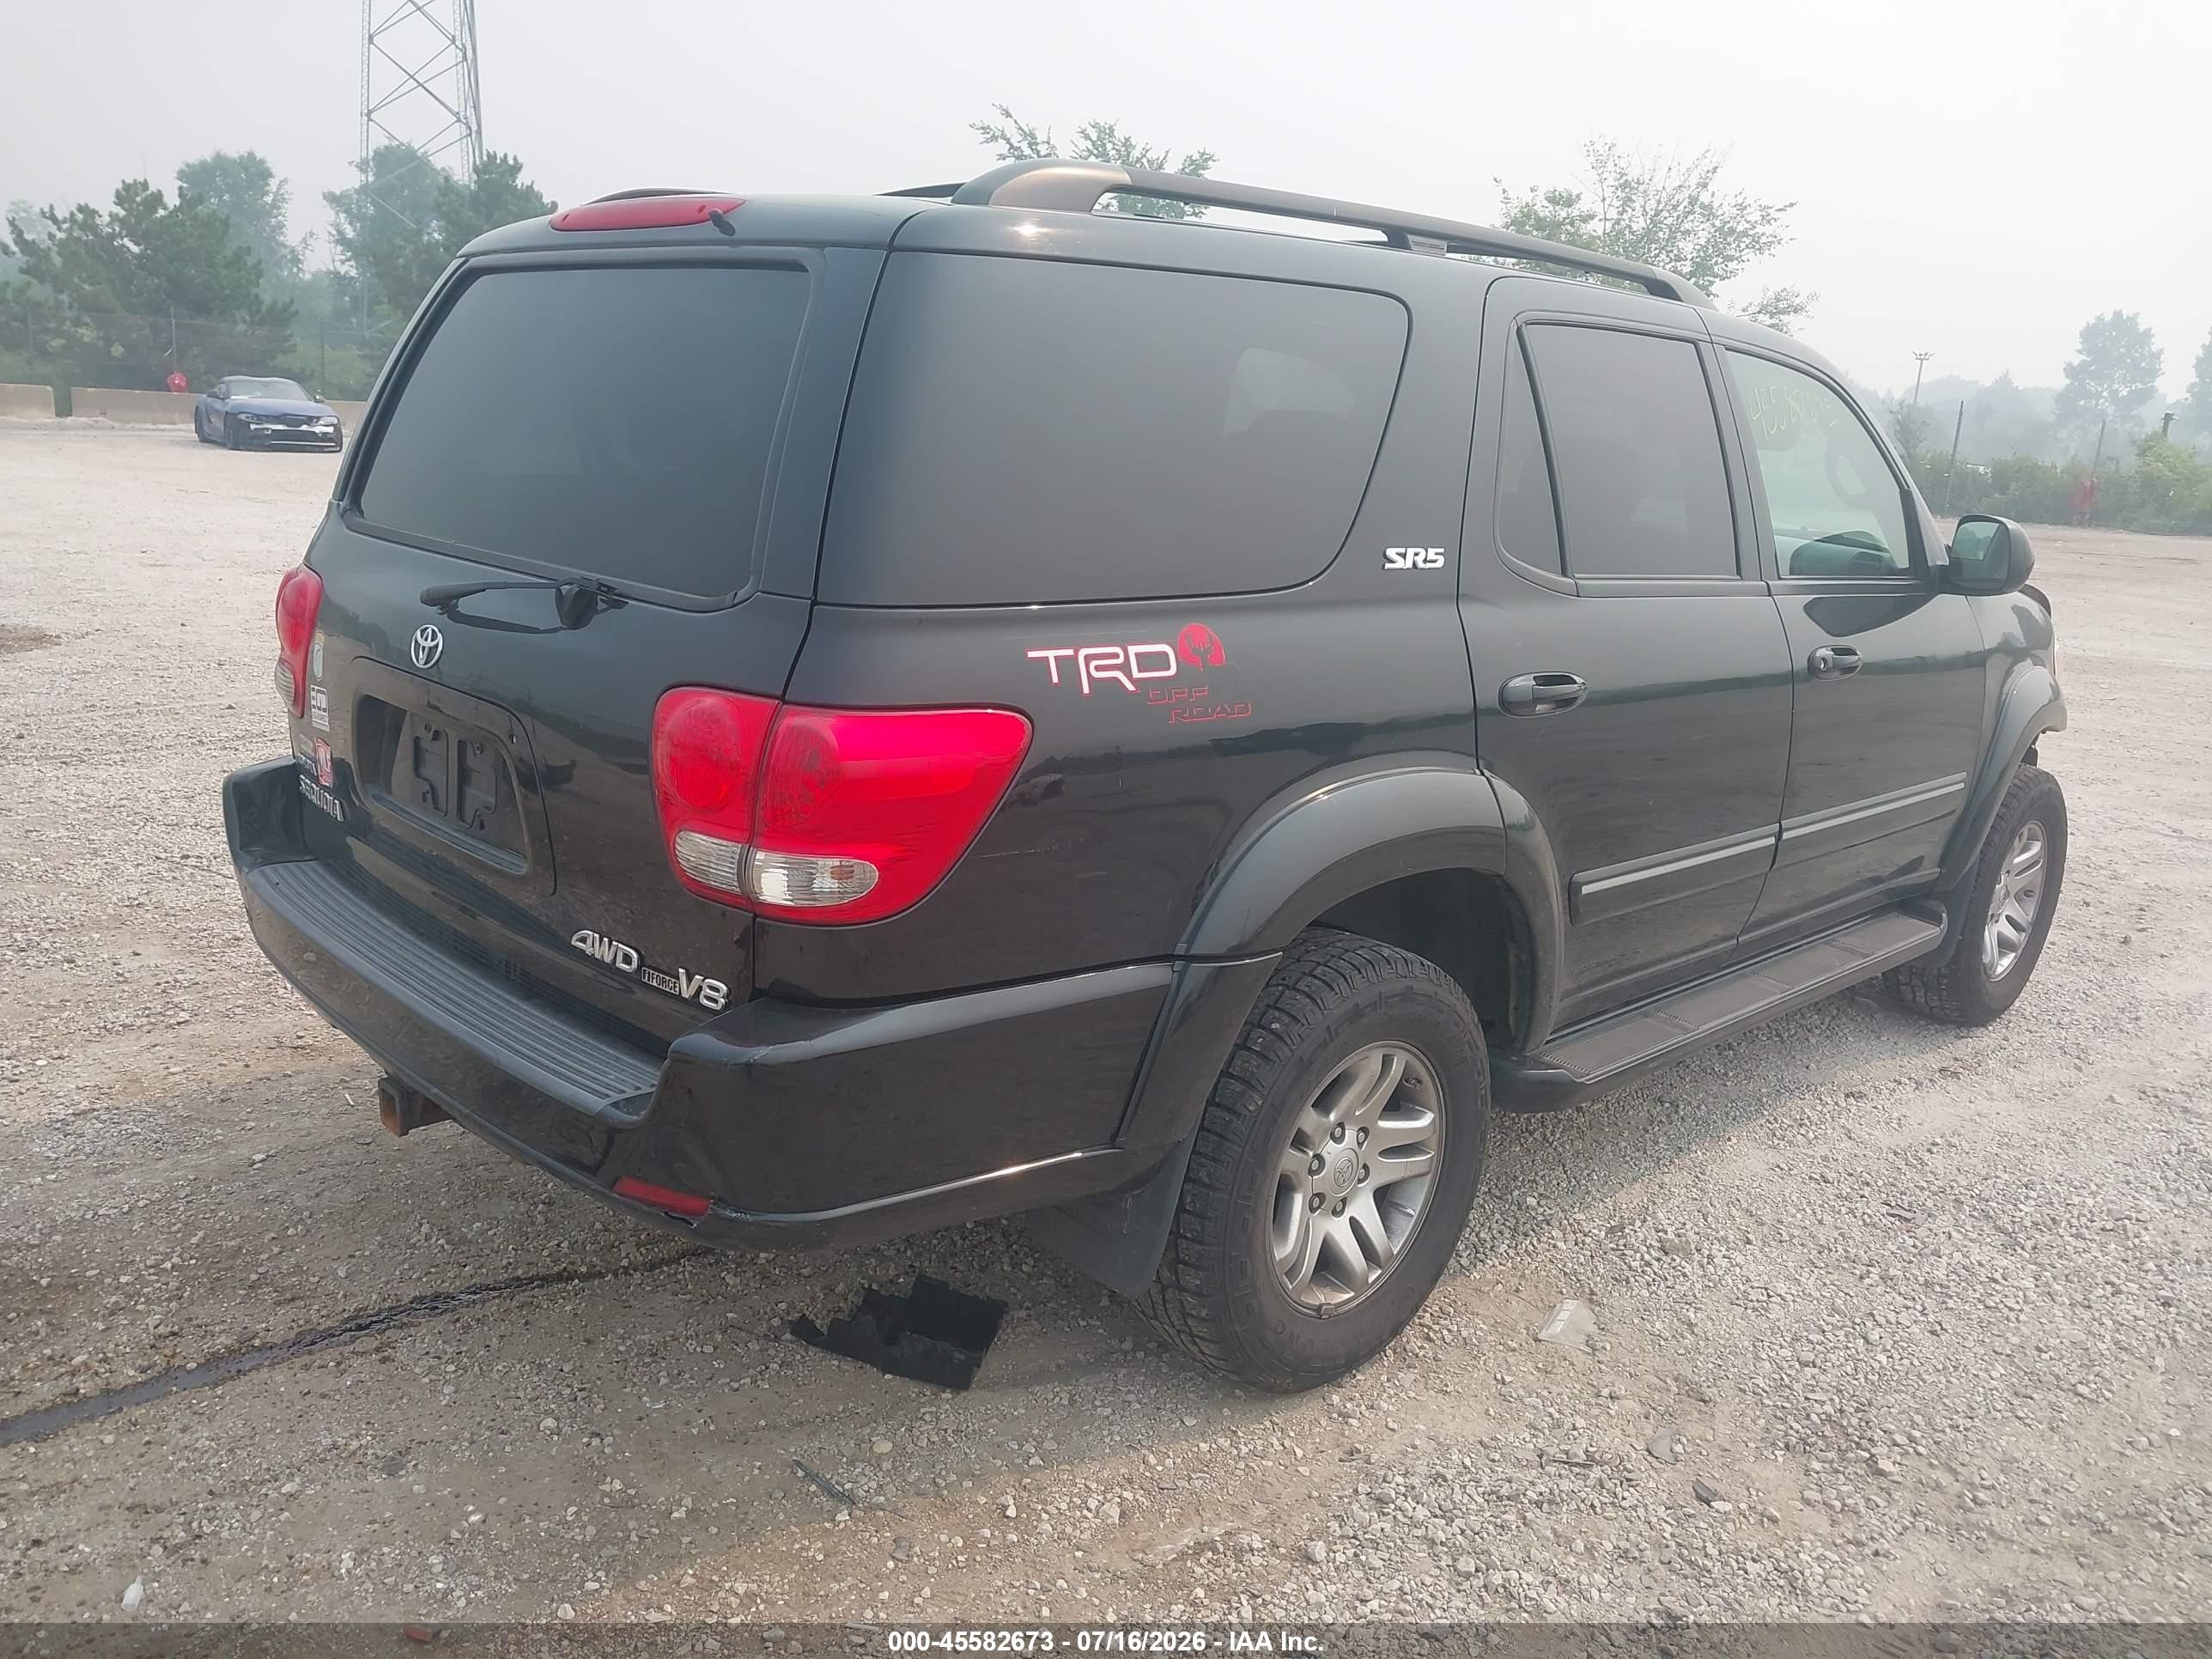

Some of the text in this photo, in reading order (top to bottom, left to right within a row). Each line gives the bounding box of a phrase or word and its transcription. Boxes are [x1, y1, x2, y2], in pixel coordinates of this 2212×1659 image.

[1382, 547, 1445, 570] SR5
[1027, 644, 1177, 694] TRD
[1147, 686, 1208, 705] OFF
[1169, 702, 1252, 723] ROAD
[299, 774, 344, 822] SEQUOIA
[570, 929, 639, 973] 4WD
[678, 968, 728, 1010] V8
